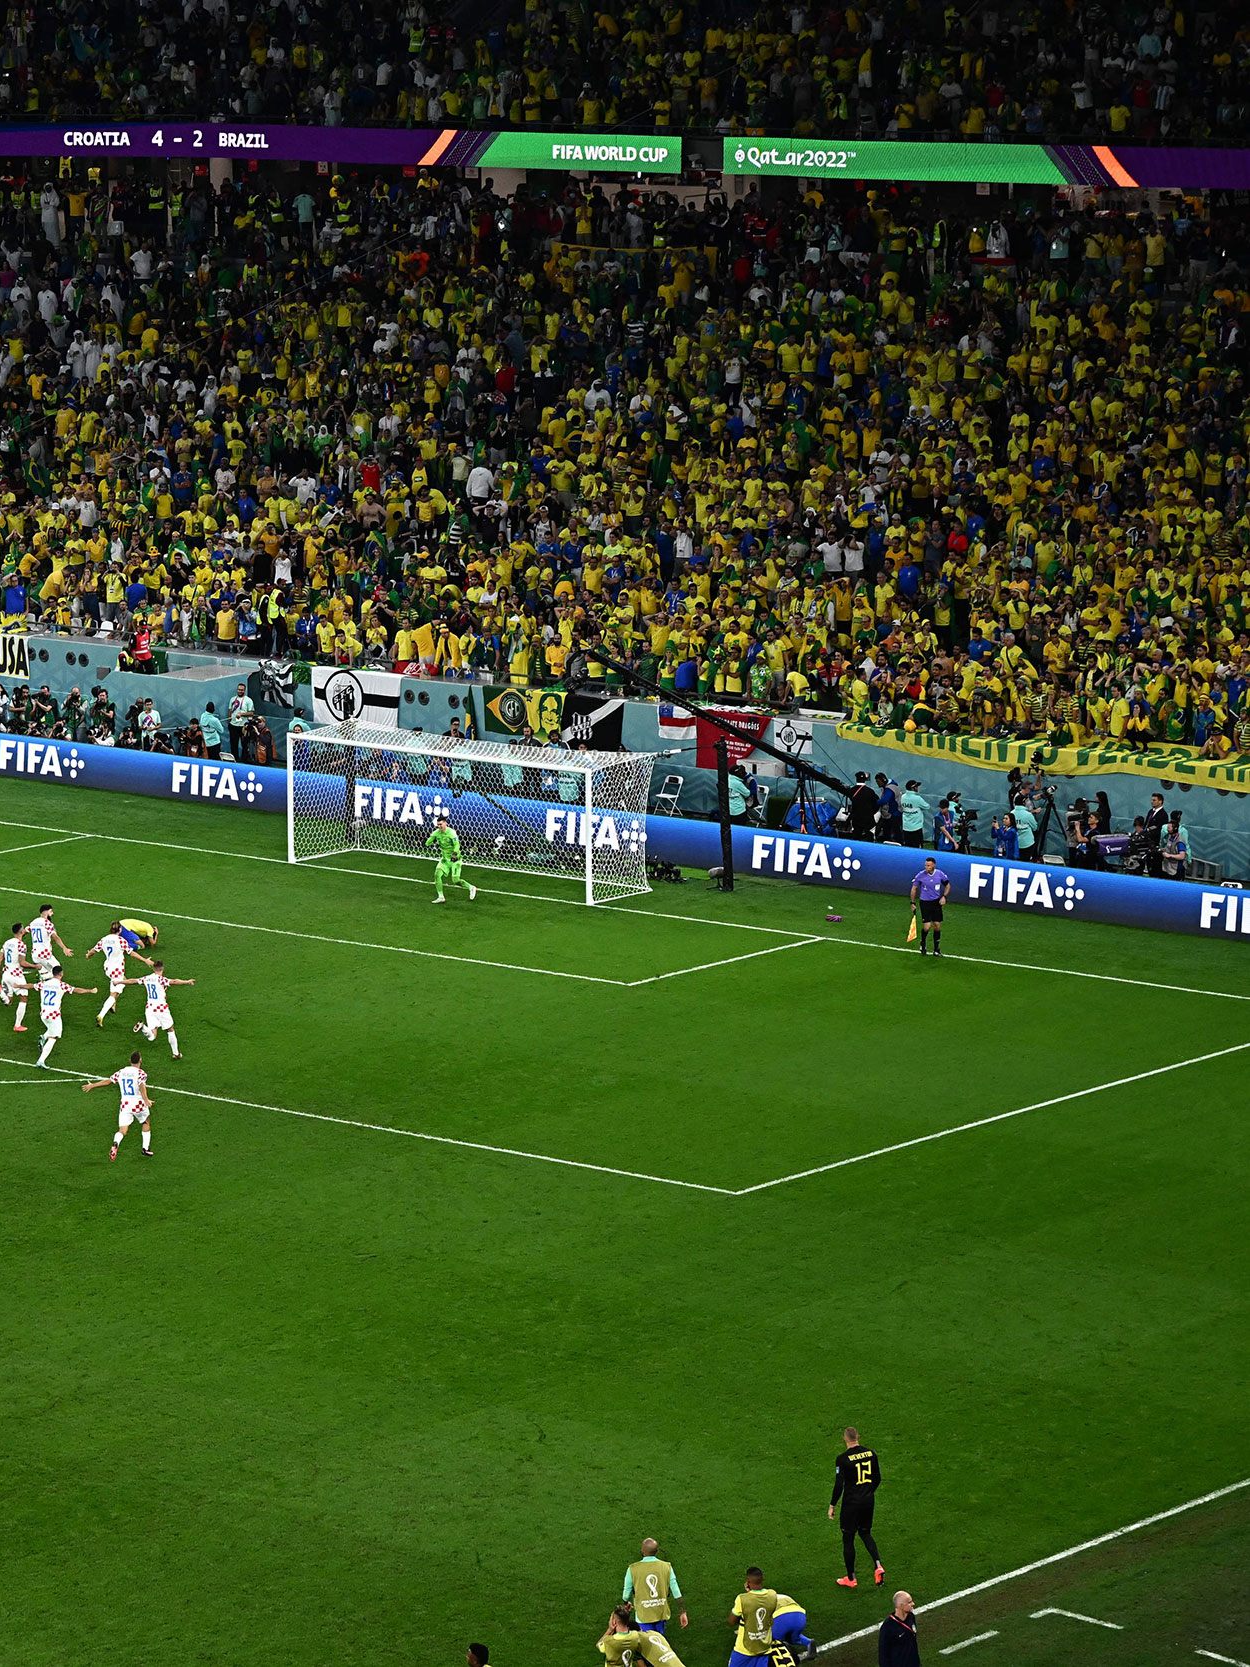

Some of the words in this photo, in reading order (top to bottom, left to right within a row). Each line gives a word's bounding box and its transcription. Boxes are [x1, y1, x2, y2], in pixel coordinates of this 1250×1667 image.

[63, 131, 131, 147] CROATIA
[151, 130, 164, 147] 4
[192, 130, 203, 147] 2
[218, 132, 269, 149] BRAZIL
[552, 144, 584, 160] FIFA
[584, 145, 638, 161] WORLD
[638, 146, 669, 163] CUP
[171, 761, 240, 802] FIFA
[354, 785, 425, 826] FIFA
[545, 808, 621, 851] FIFA
[751, 834, 832, 879] FIFA
[968, 862, 1054, 910] FIFA
[1200, 892, 1250, 934] FI
[31, 927, 43, 944] 20
[6, 949, 12, 963] 6
[106, 946, 114, 958] 7
[42, 990, 57, 1006] 22
[147, 984, 158, 1000] 18
[121, 1078, 135, 1096] 13
[855, 1460, 872, 1486] 12
